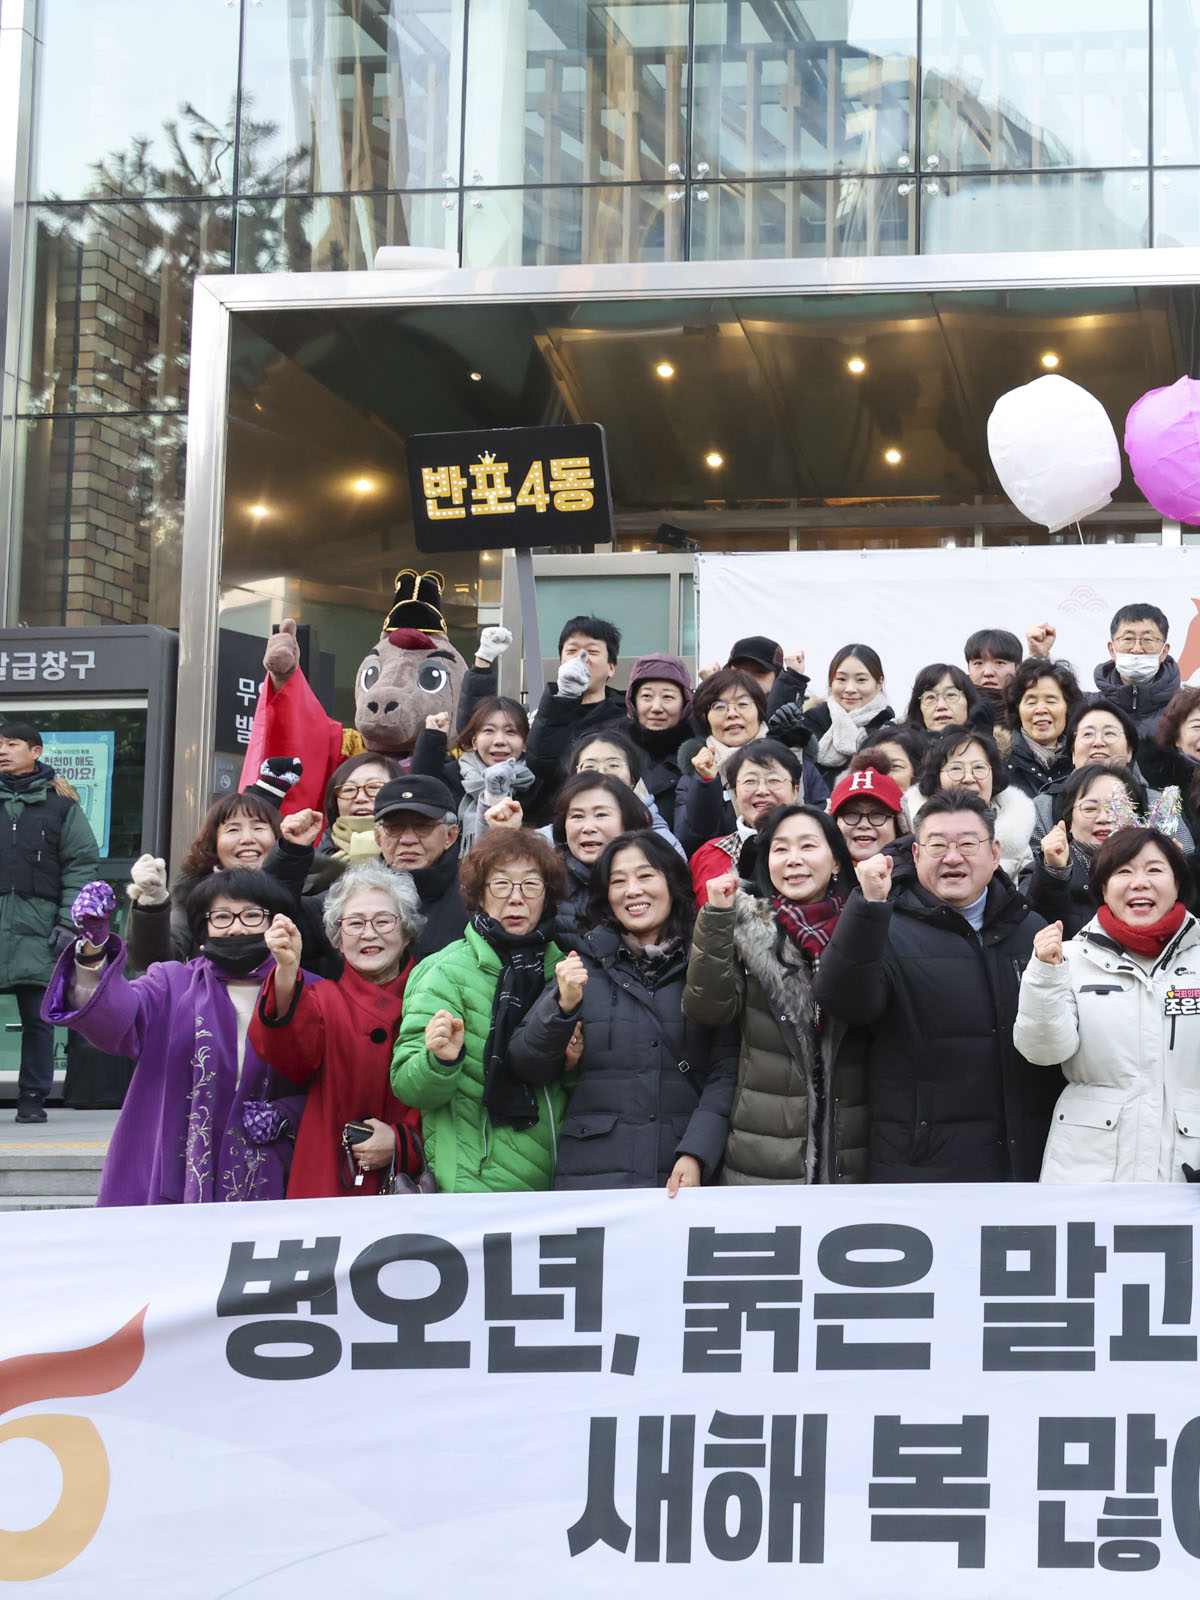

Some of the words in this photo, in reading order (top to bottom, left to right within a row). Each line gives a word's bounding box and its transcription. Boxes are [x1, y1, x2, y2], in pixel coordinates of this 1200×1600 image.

[421, 456, 595, 521] 반포4동
[849, 771, 874, 790] H
[216, 1226, 640, 1381] 병오년,
[682, 1223, 935, 1373] 붉은
[566, 1409, 828, 1564] 새해
[868, 1415, 991, 1569] 복
